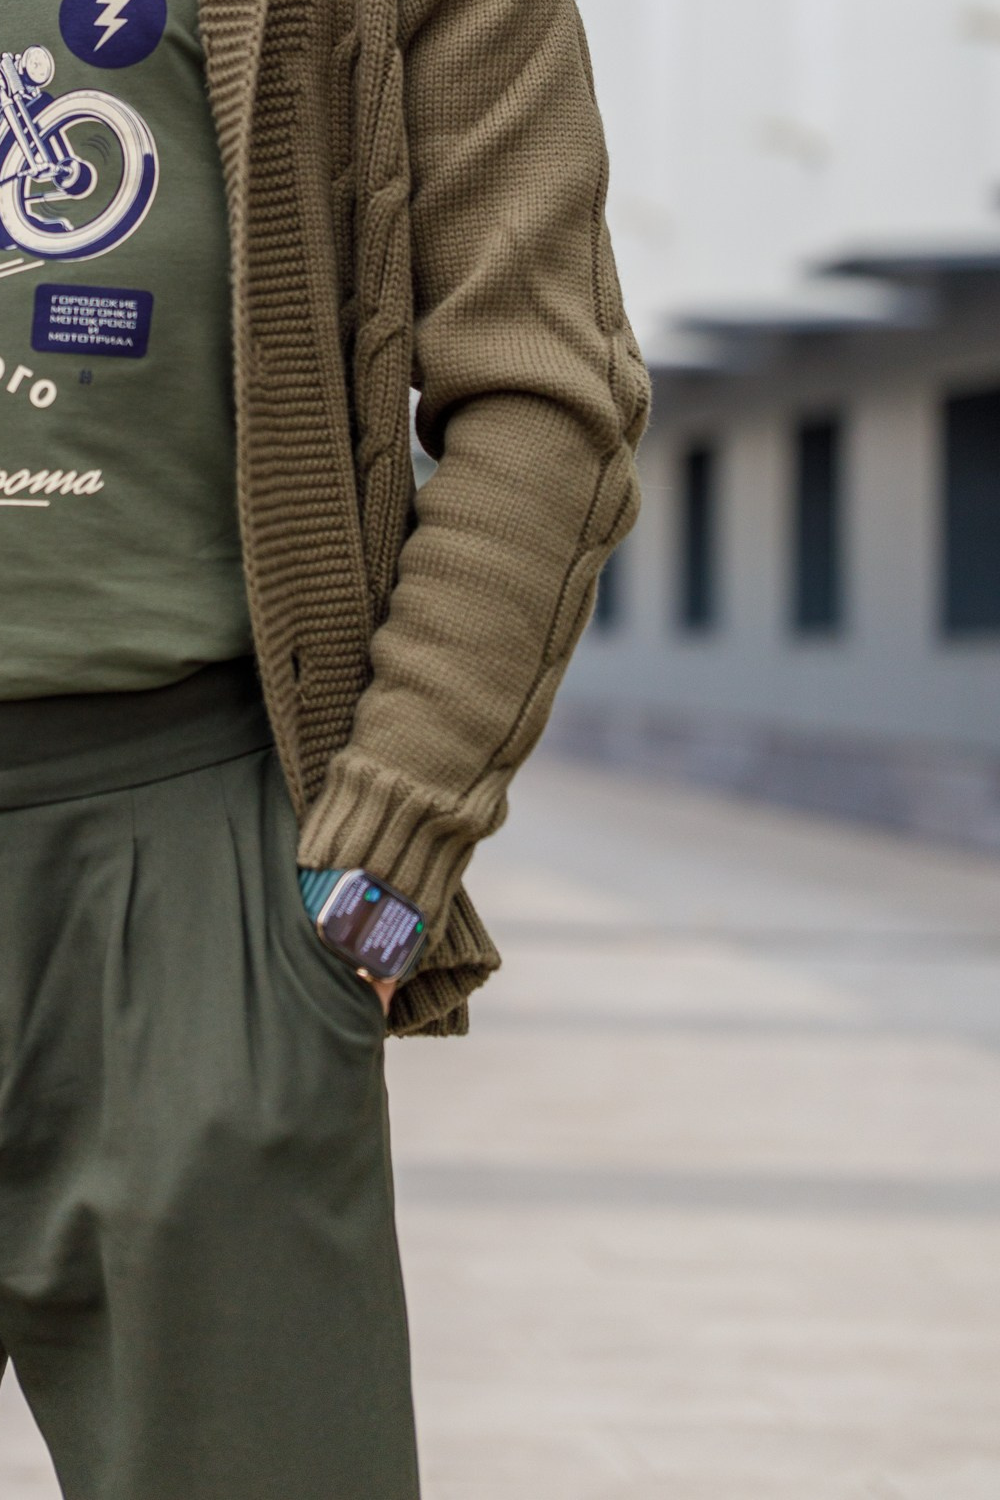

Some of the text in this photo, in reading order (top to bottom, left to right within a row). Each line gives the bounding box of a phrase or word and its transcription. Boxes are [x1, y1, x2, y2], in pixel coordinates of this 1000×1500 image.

[51, 295, 138, 310] ГОРОДСКИЕ
[50, 305, 138, 319] МОТОГОНКИ
[49, 315, 137, 329] МОТОКРОСС
[48, 332, 134, 347] МОТОТРИАЛ
